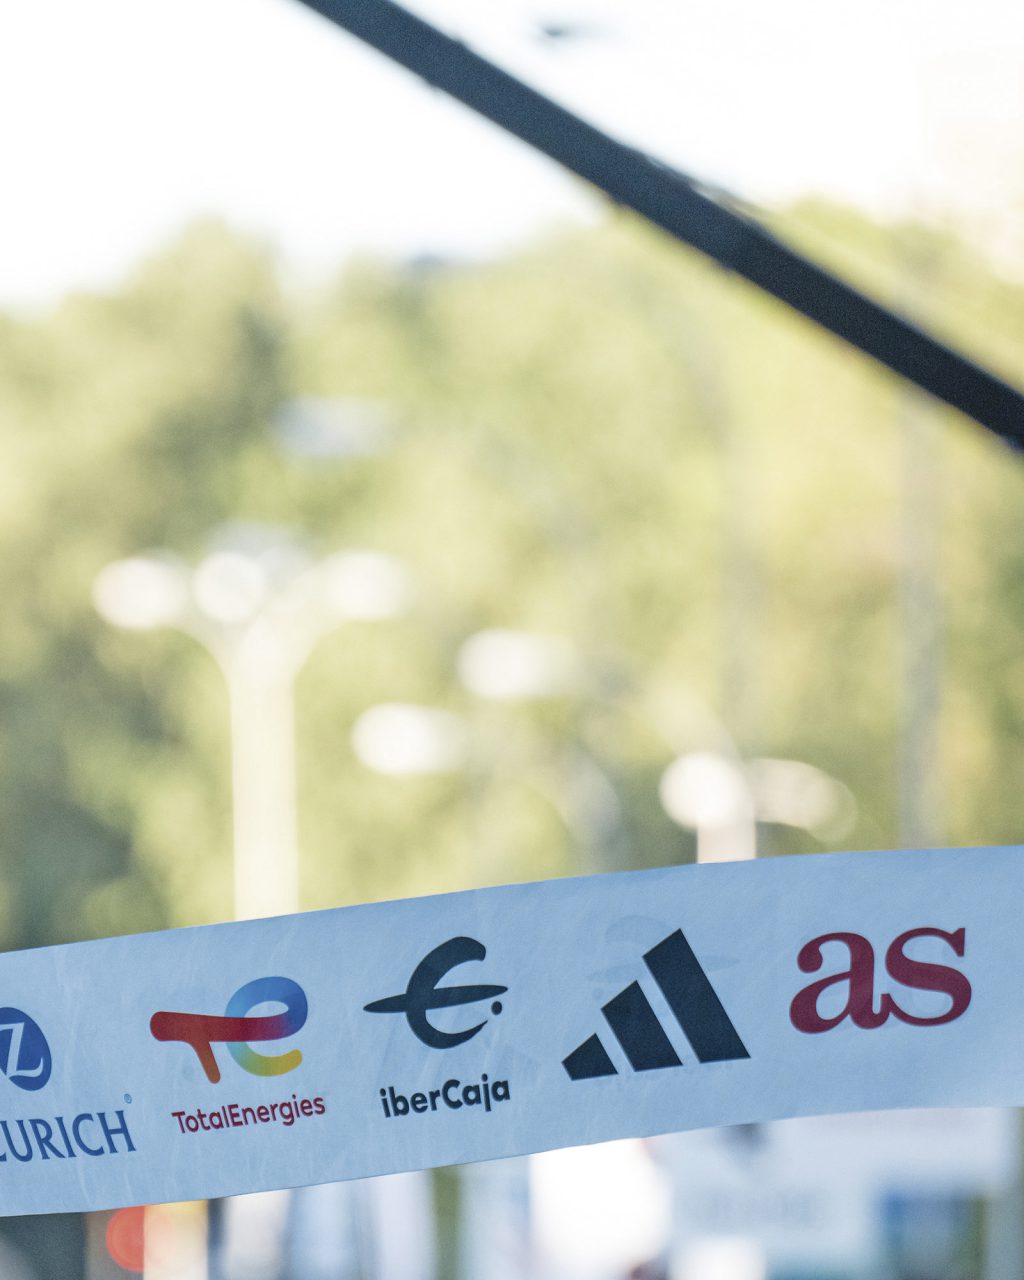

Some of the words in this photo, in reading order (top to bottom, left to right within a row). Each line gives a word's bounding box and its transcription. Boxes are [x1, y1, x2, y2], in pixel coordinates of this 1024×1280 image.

[789, 927, 972, 1034] as
[171, 1094, 326, 1134] TotalEnergies
[379, 1073, 511, 1118] iberCaja
